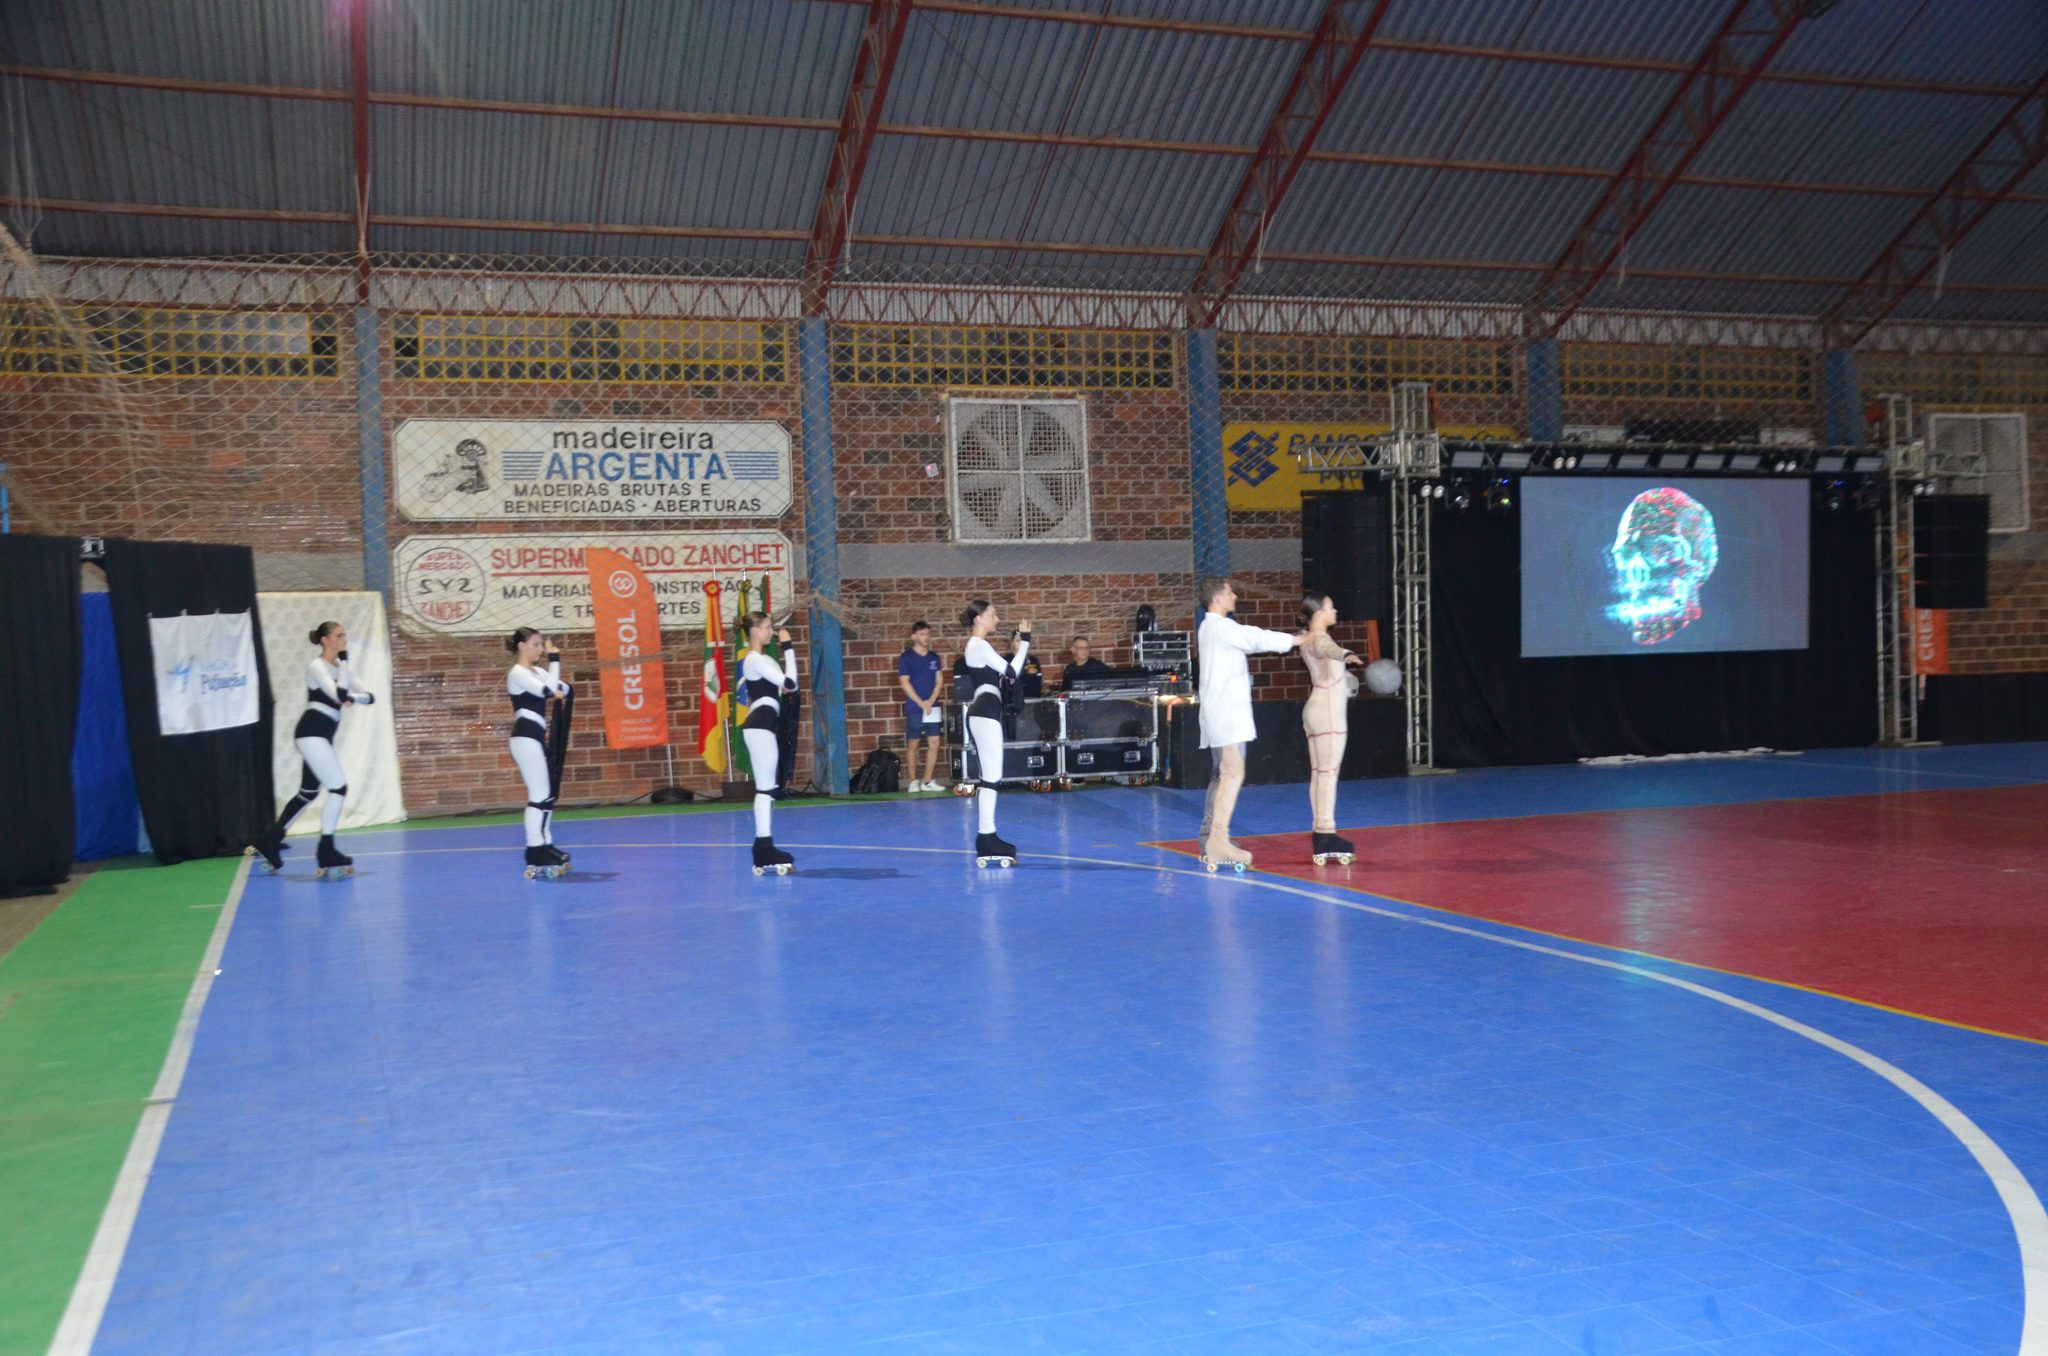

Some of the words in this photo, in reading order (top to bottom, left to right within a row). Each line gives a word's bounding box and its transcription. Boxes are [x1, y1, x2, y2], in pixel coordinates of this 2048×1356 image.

[553, 427, 714, 449] madeireira
[545, 452, 728, 481] ARGENTA
[514, 483, 609, 497] MADEIRAS
[620, 483, 692, 497] BRUTAS
[701, 483, 711, 496] E
[504, 500, 636, 514] BENEFICIADAS
[654, 498, 762, 513] ABERTURAS
[491, 545, 675, 570] SUPERMADO
[683, 543, 784, 566] ZANCHET
[553, 605, 563, 618] E
[617, 609, 645, 711] CRESOL
